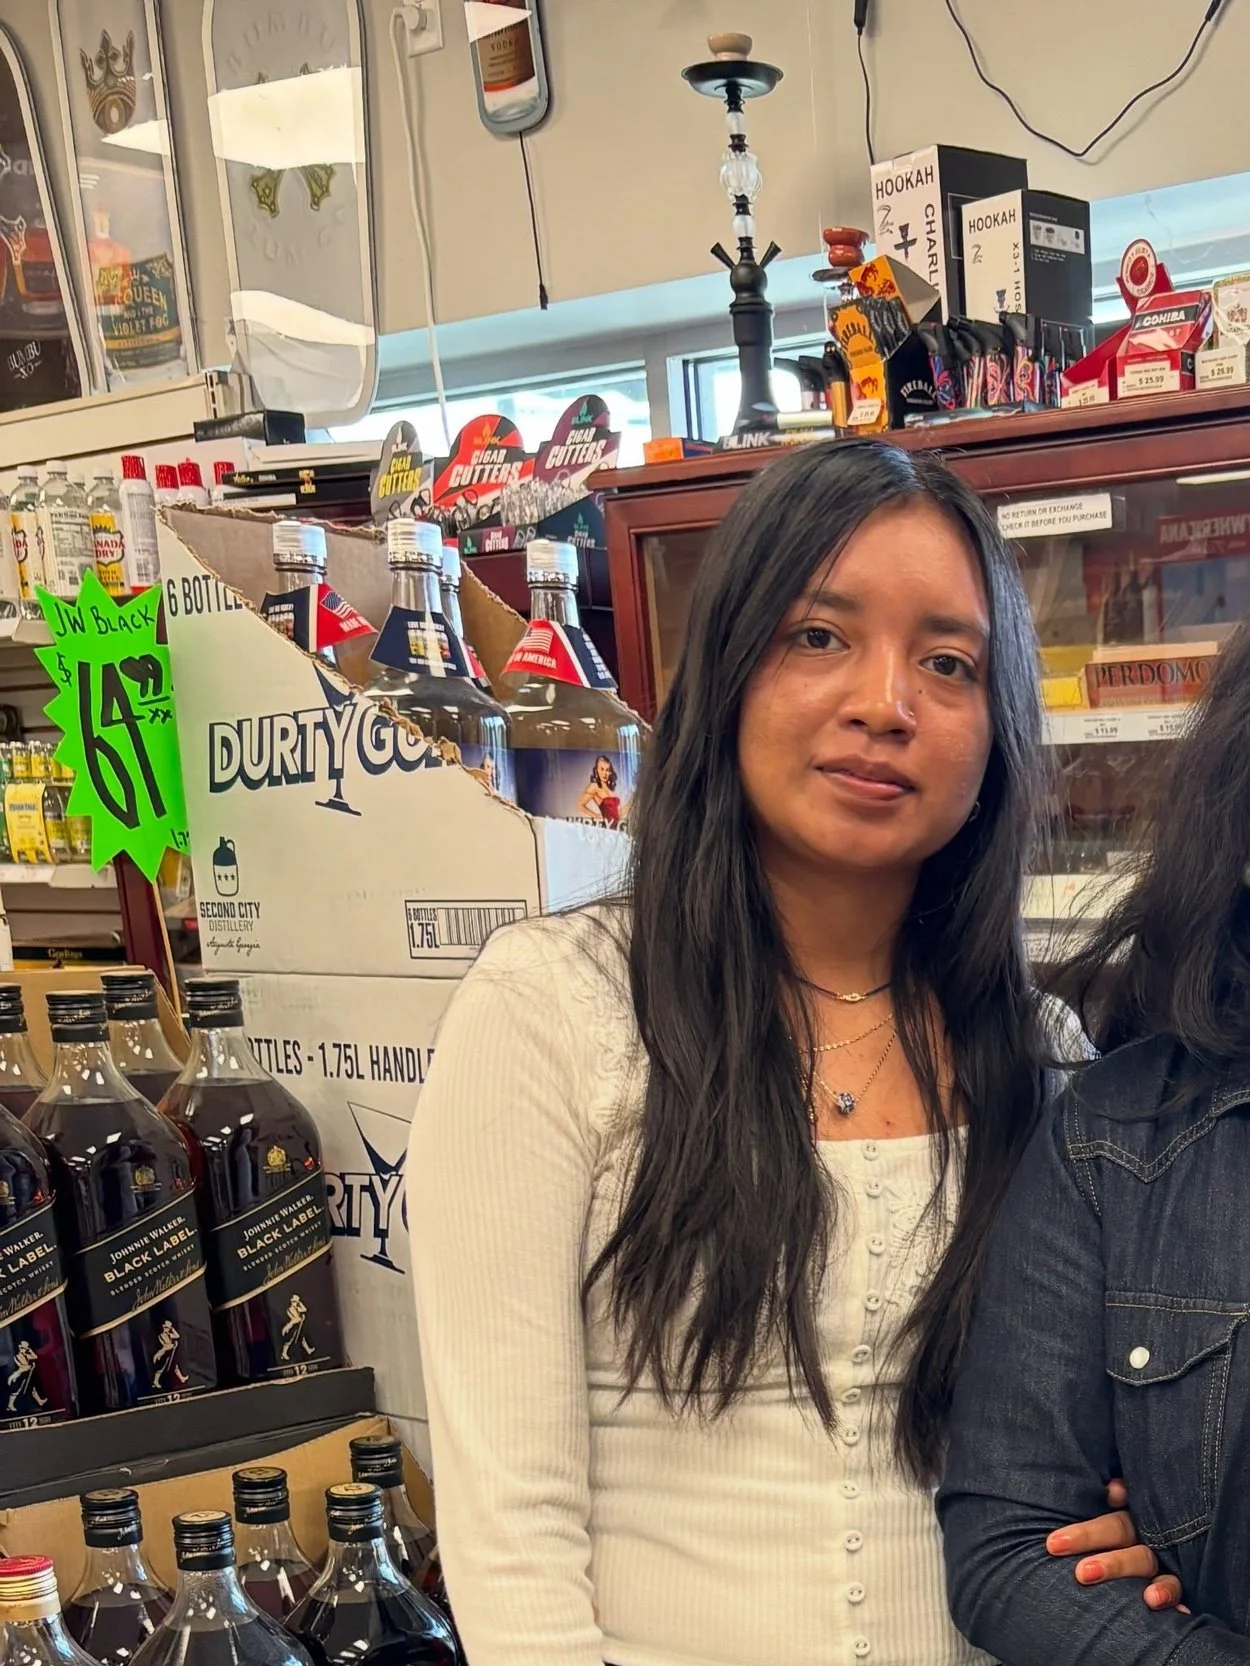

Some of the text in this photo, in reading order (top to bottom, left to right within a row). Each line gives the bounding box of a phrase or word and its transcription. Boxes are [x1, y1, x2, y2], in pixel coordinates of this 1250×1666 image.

[875, 165, 935, 200] HOOKAH
[968, 208, 1017, 234] HOOKAH
[1142, 309, 1186, 327] COHIBA
[565, 427, 596, 445] CIGAR
[471, 449, 507, 465] CIGAR
[545, 440, 606, 470] CUTTERS
[449, 462, 523, 487] CUTTERS
[1001, 502, 1084, 520] NO RETURN OR EXCHANGE
[1001, 510, 1108, 533] CHECK IT BEFORE YOU PURCHASE
[166, 578, 178, 617] 6
[54, 602, 87, 638] JW
[1094, 659, 1211, 690] PERDOMO
[209, 706, 357, 793] DURTY
[199, 901, 261, 920] SECOND CITY
[413, 907, 438, 922] BOTTLES
[208, 919, 254, 933] DISTILLERY
[409, 922, 441, 950] 1.75L
[242, 1214, 281, 1241] JOHNNIE
[110, 1236, 151, 1265] JOHNNIE
[236, 1227, 283, 1260] BLACK
[103, 1252, 152, 1284] BLACK
[22, 1416, 38, 1430] 12
